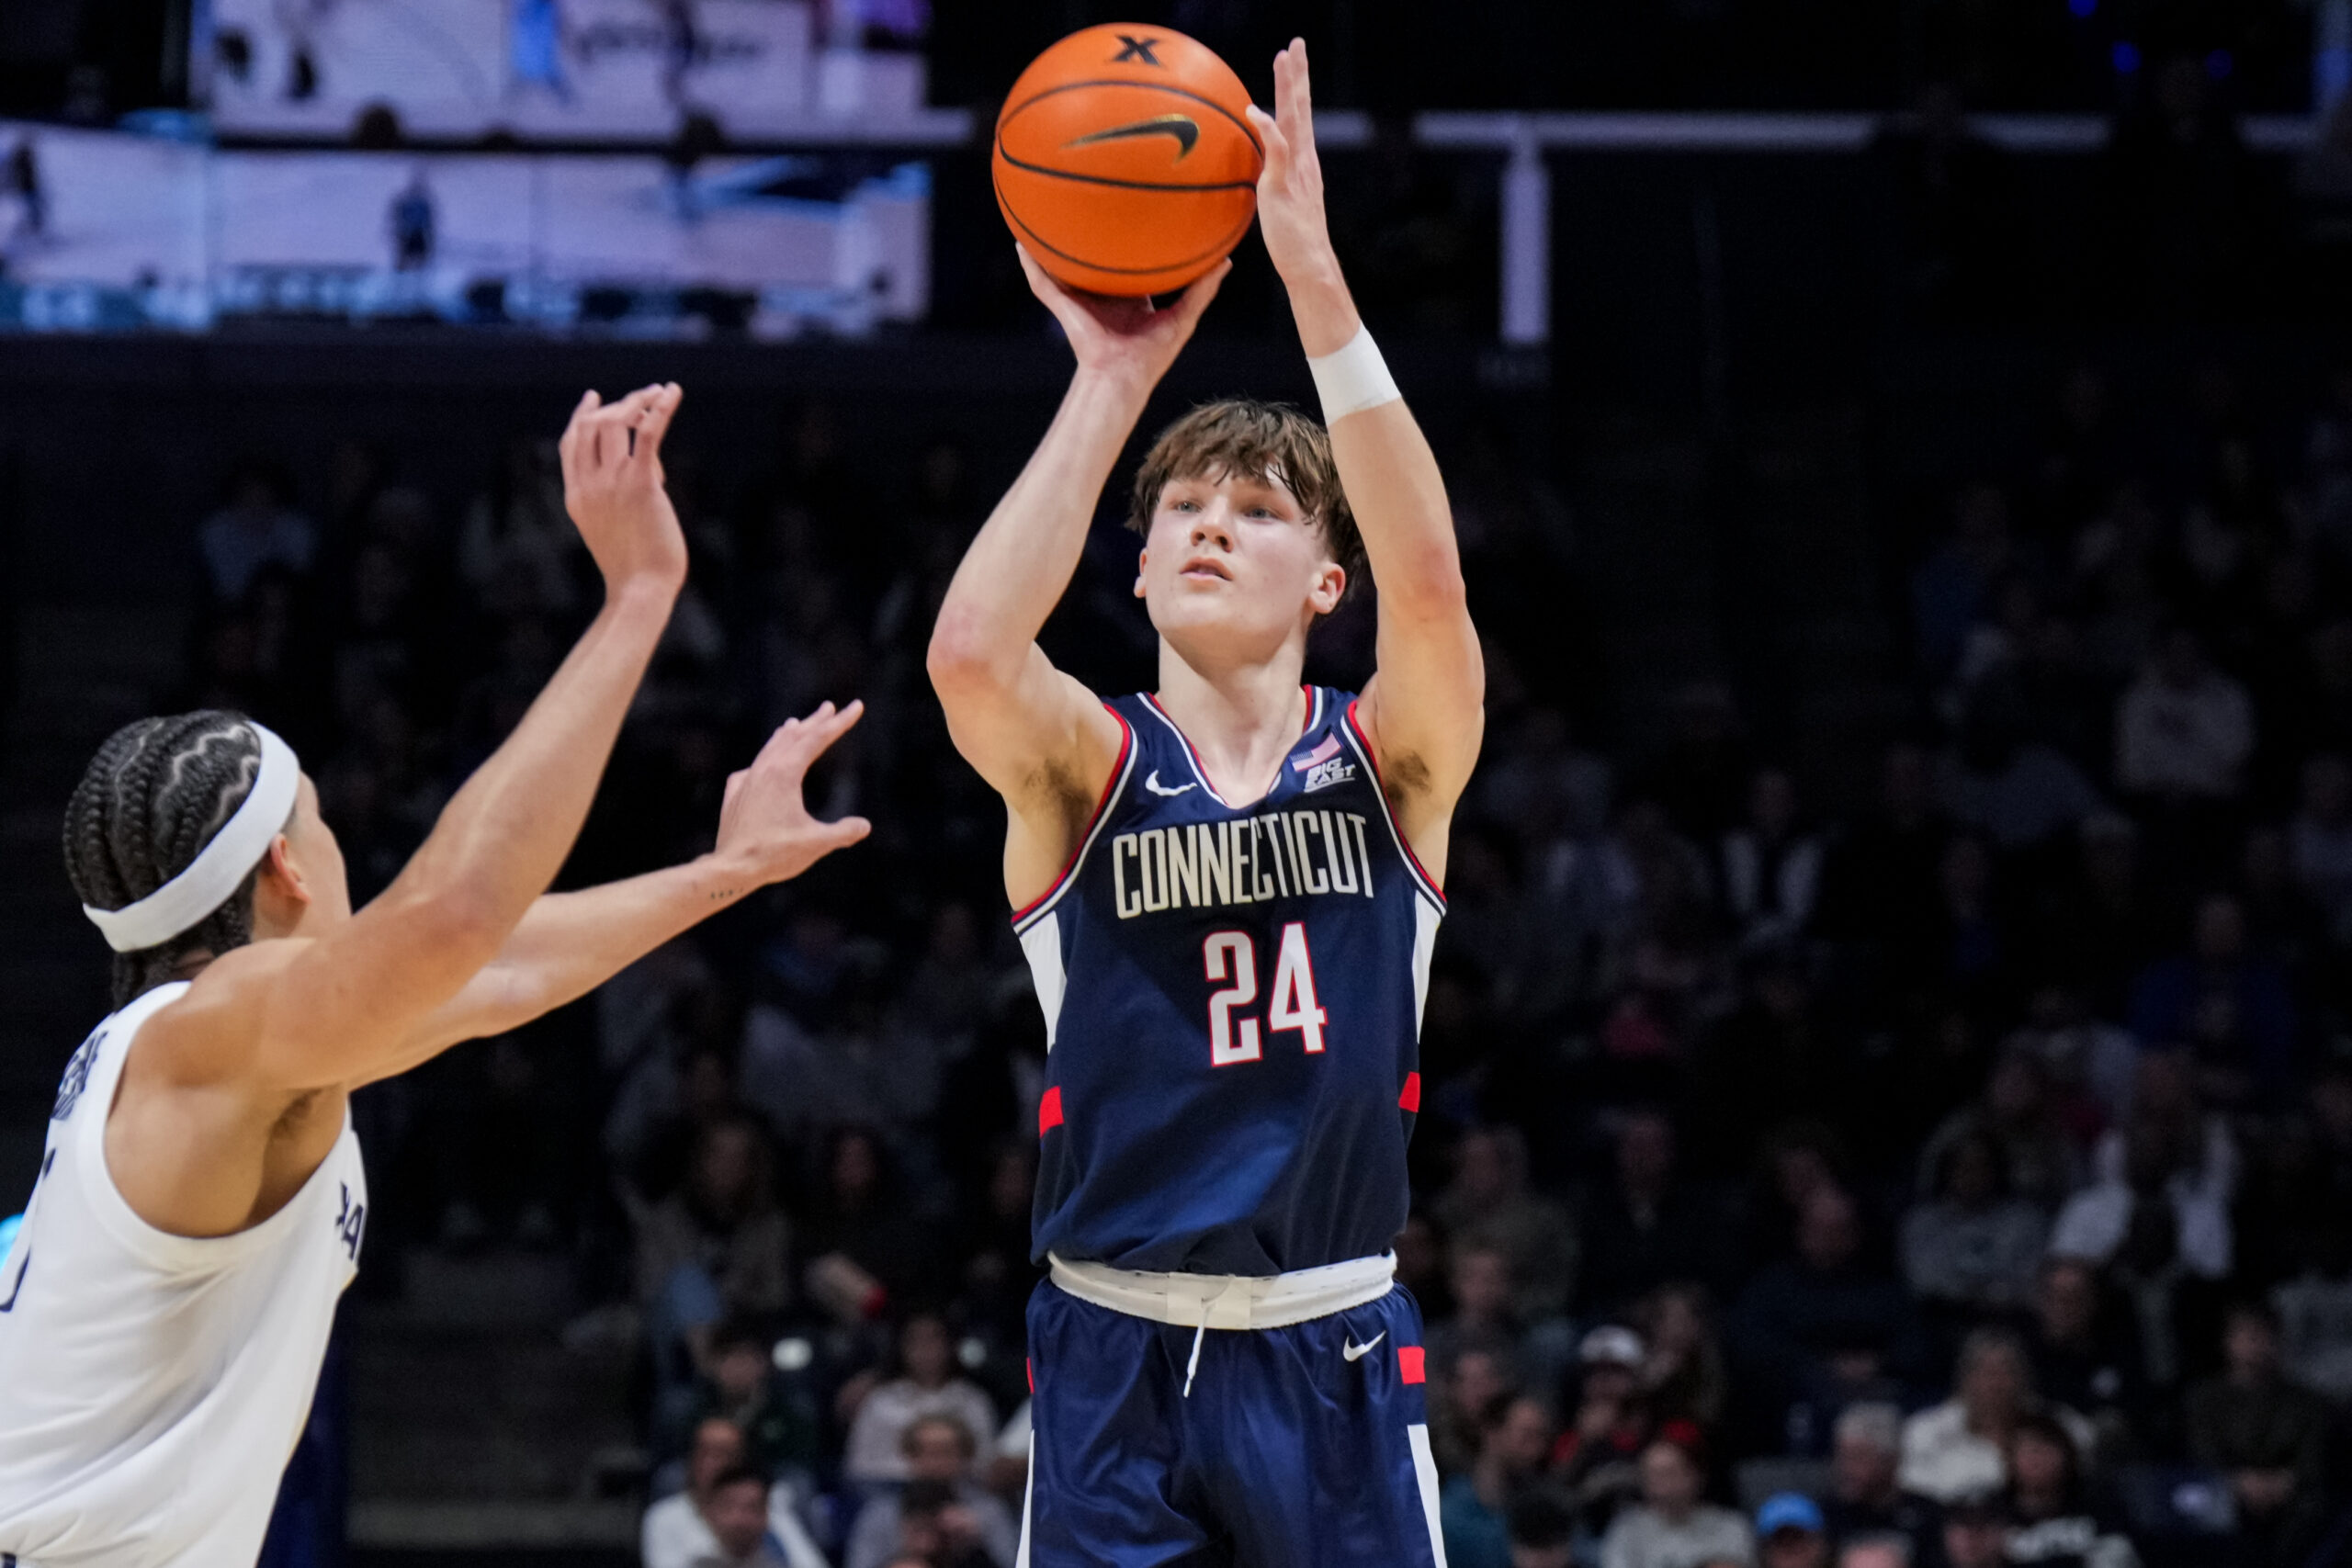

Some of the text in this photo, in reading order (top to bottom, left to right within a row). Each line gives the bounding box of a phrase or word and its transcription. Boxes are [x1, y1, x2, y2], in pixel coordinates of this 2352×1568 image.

[1114, 35, 1160, 66] X
[1308, 757, 1342, 776] BIG
[1113, 810, 1374, 919] CONNECTICUT
[1203, 921, 1328, 1066] 24
